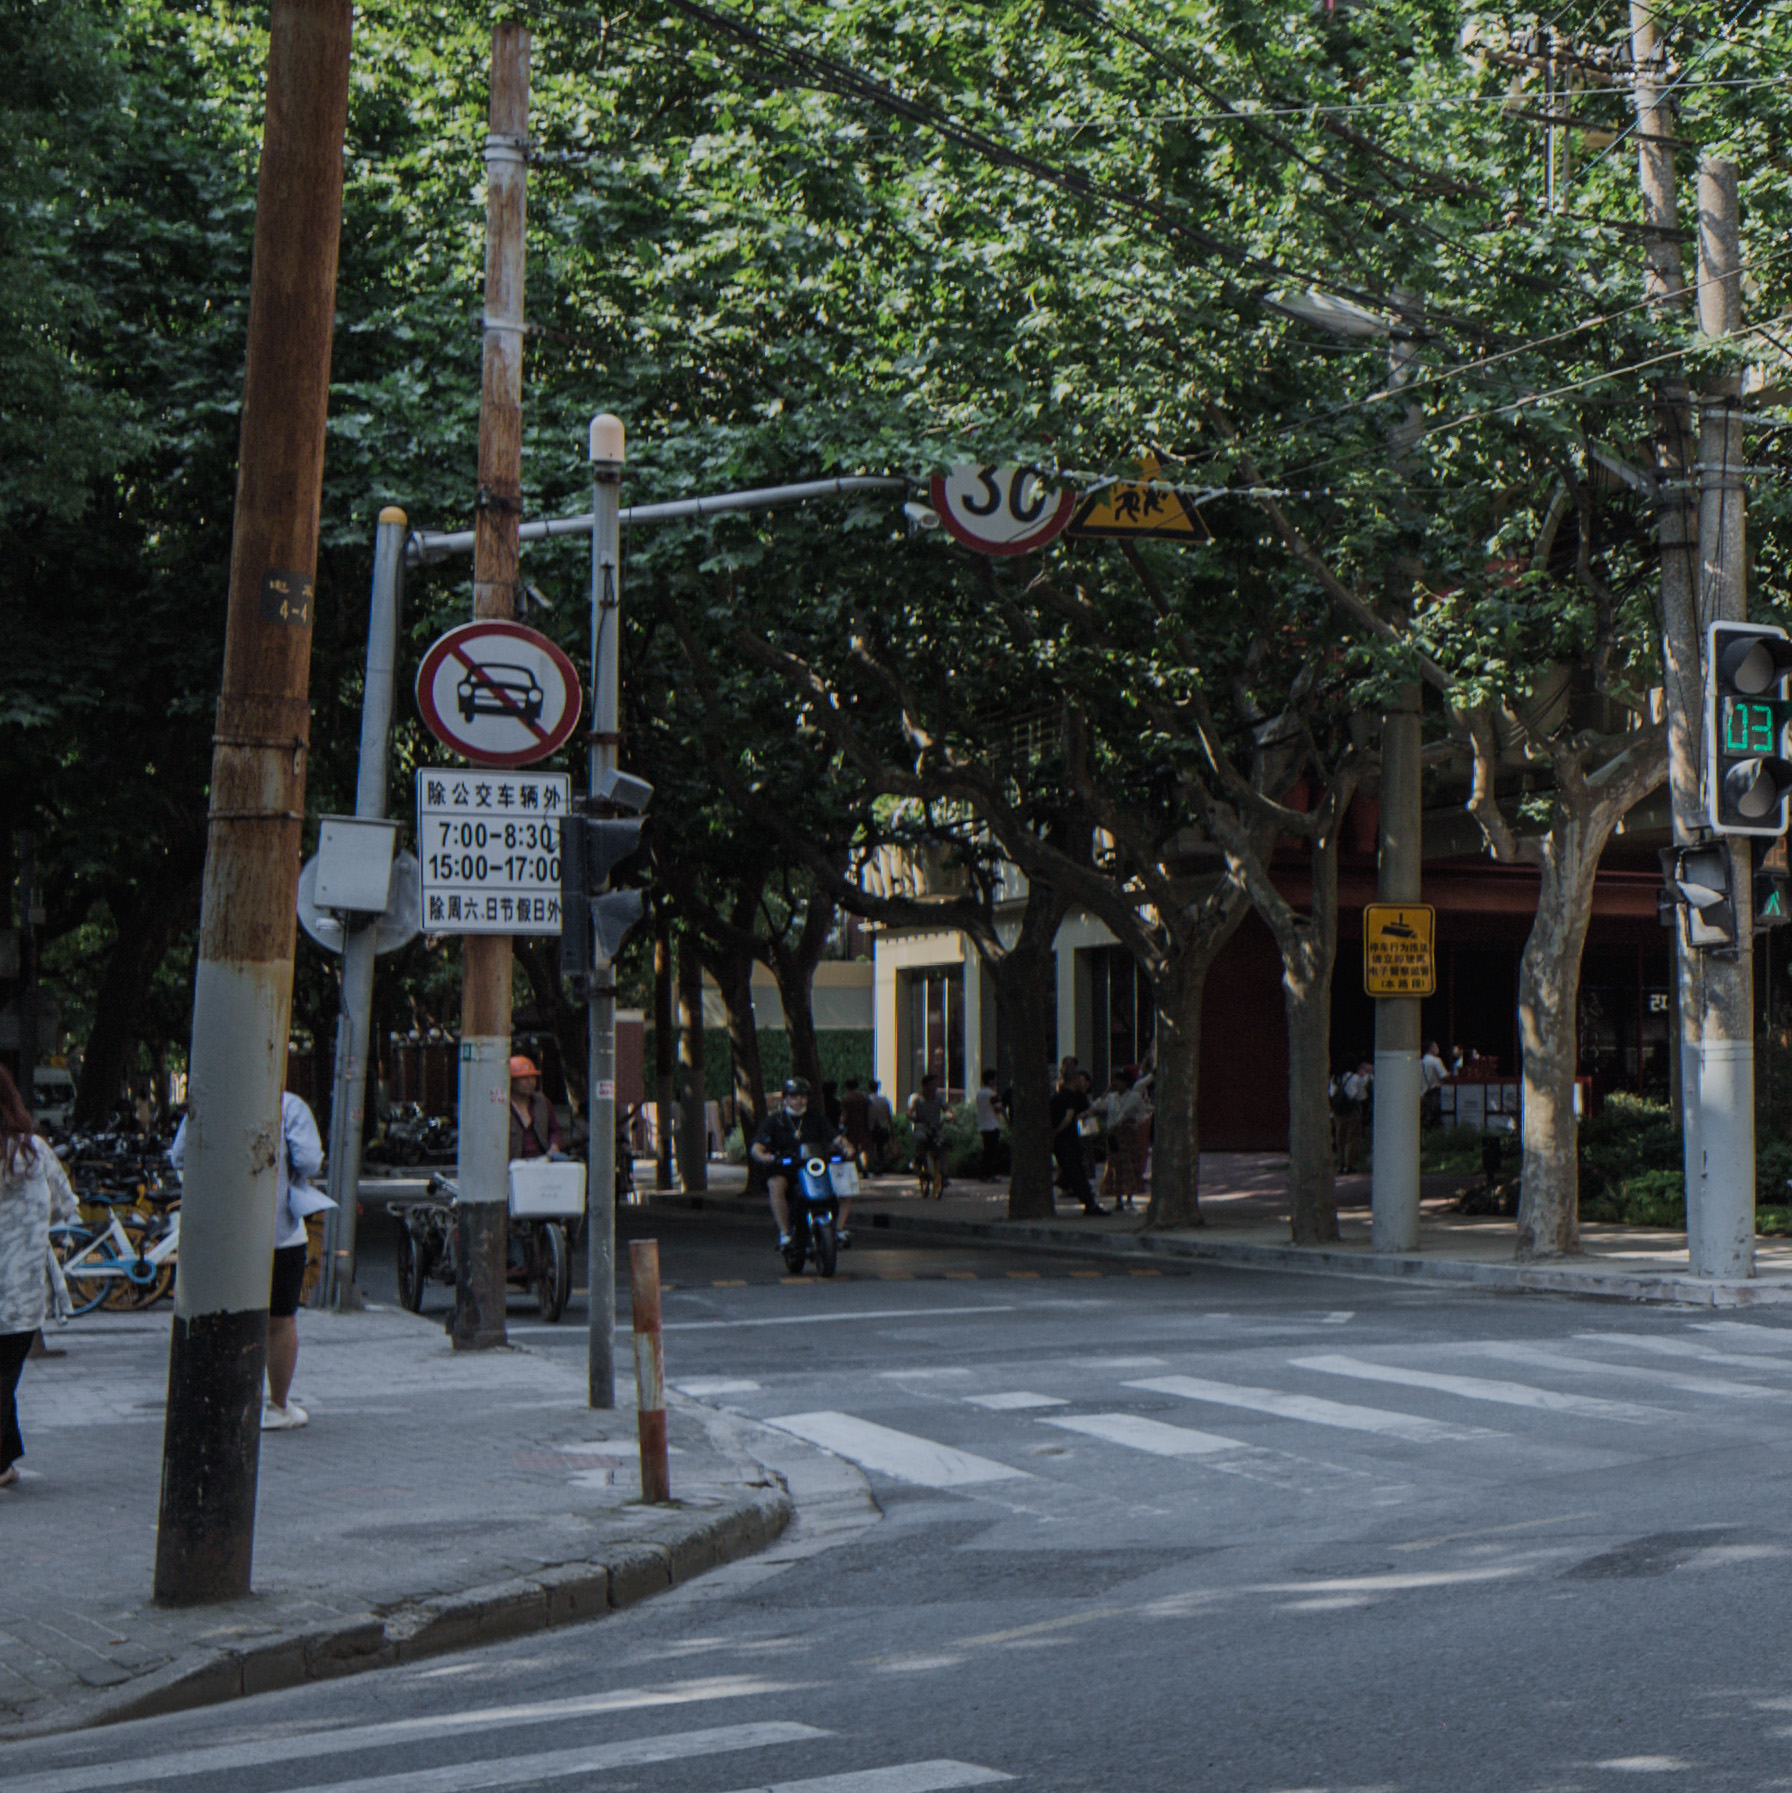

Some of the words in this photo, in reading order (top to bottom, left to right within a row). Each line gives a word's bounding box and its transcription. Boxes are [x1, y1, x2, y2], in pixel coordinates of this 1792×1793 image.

[960, 464, 1047, 523] 30
[1726, 703, 1773, 751] 03
[427, 780, 562, 809] 除公交车辆外
[438, 820, 553, 850] 7:00-8:30
[428, 854, 561, 882] 15:00-17:00
